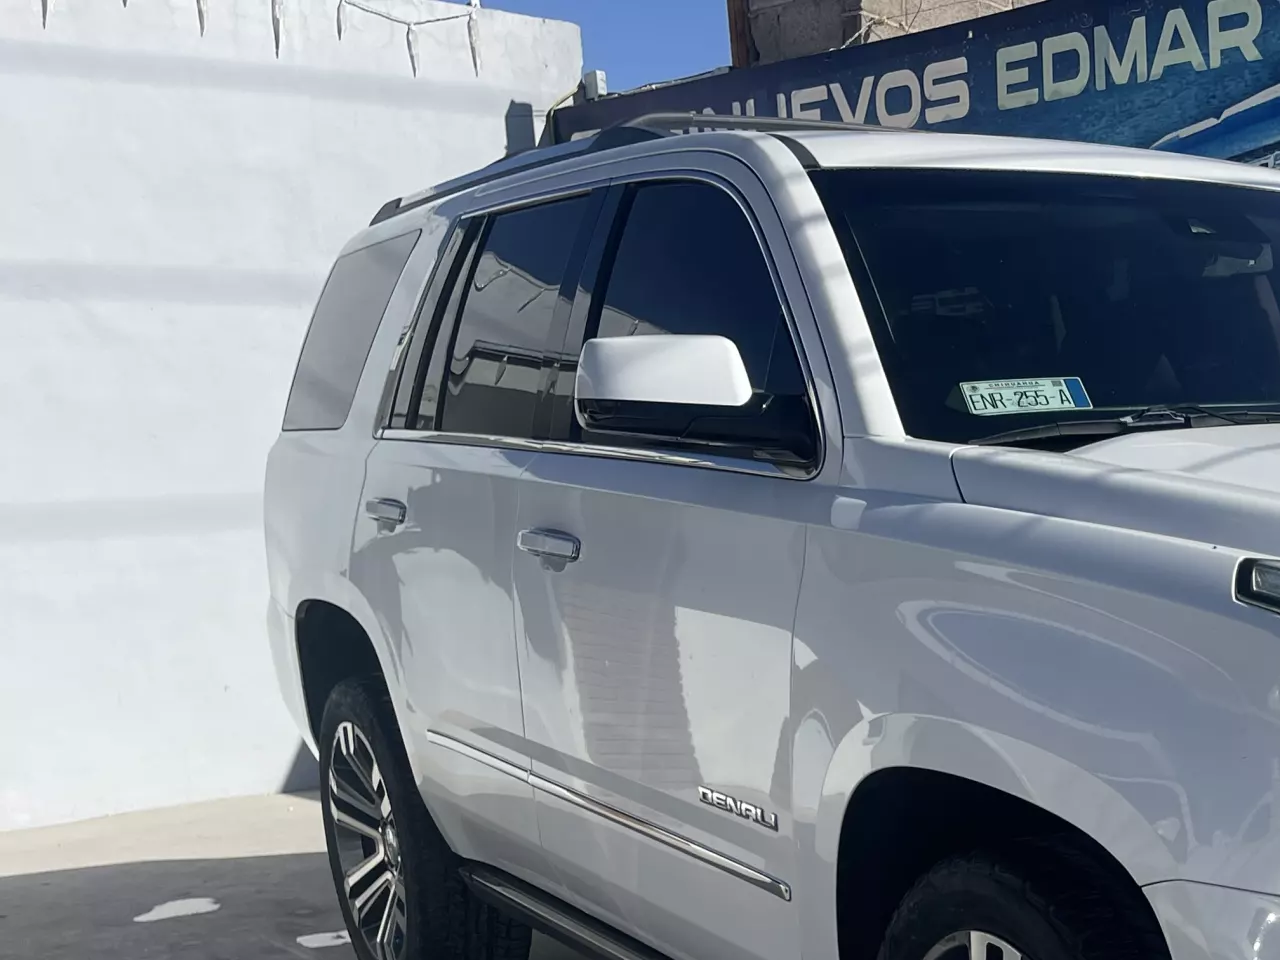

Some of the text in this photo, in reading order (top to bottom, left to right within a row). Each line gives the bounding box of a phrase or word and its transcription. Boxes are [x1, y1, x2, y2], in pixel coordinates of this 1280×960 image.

[996, 0, 1263, 110] EDMAR
[968, 389, 1072, 411] ENR-255-A
[698, 785, 779, 832] DENALI
